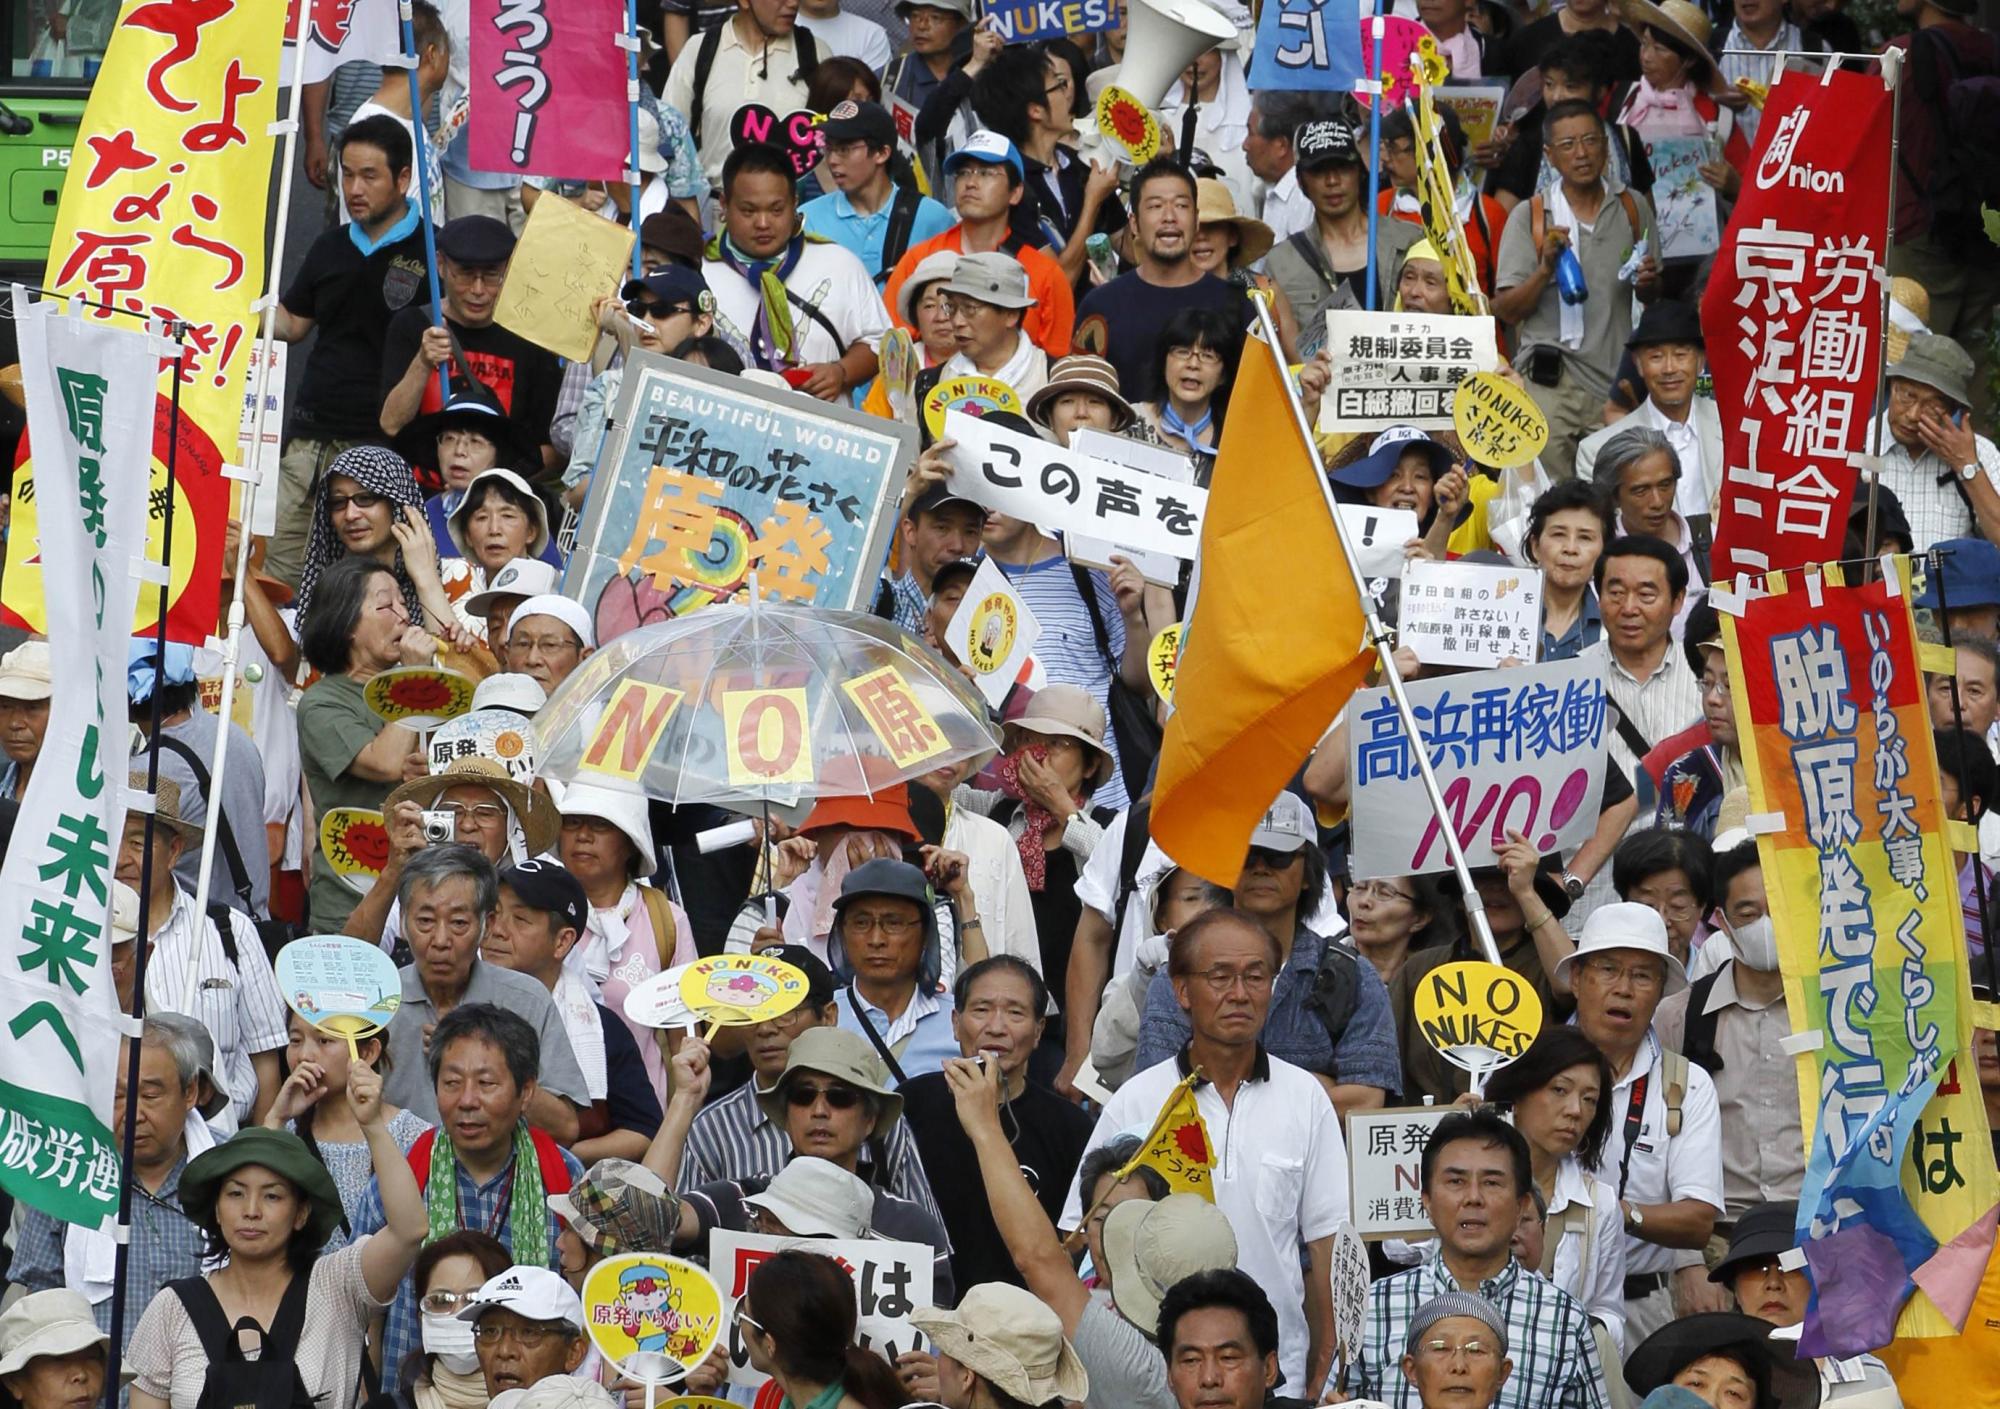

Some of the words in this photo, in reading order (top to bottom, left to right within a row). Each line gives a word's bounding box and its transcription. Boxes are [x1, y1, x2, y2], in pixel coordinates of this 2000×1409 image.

[988, 2, 1116, 39] NUKES!
[1350, 335, 1473, 360] 規制委員会
[1390, 324, 1431, 334] 原子力
[1340, 388, 1456, 417] 白紙撤回を
[1776, 234, 1875, 540] 労働組合
[649, 385, 783, 438] BEAUTIFUL
[794, 425, 882, 465] WORLD
[1463, 376, 1493, 402] NO
[1489, 393, 1545, 442] NUKES
[1454, 606, 1520, 624] 許さない!
[1357, 678, 1607, 787] 高浜再稼働
[1411, 768, 1589, 871] NO!
[696, 959, 729, 976] NO
[735, 959, 800, 991] NUKES
[1431, 970, 1521, 1017] NO
[1421, 1013, 1533, 1058] NUKES
[0, 1106, 121, 1203] 版労連
[495, 1283, 523, 1291] adidas
[592, 1303, 716, 1333] 原発いらない!
